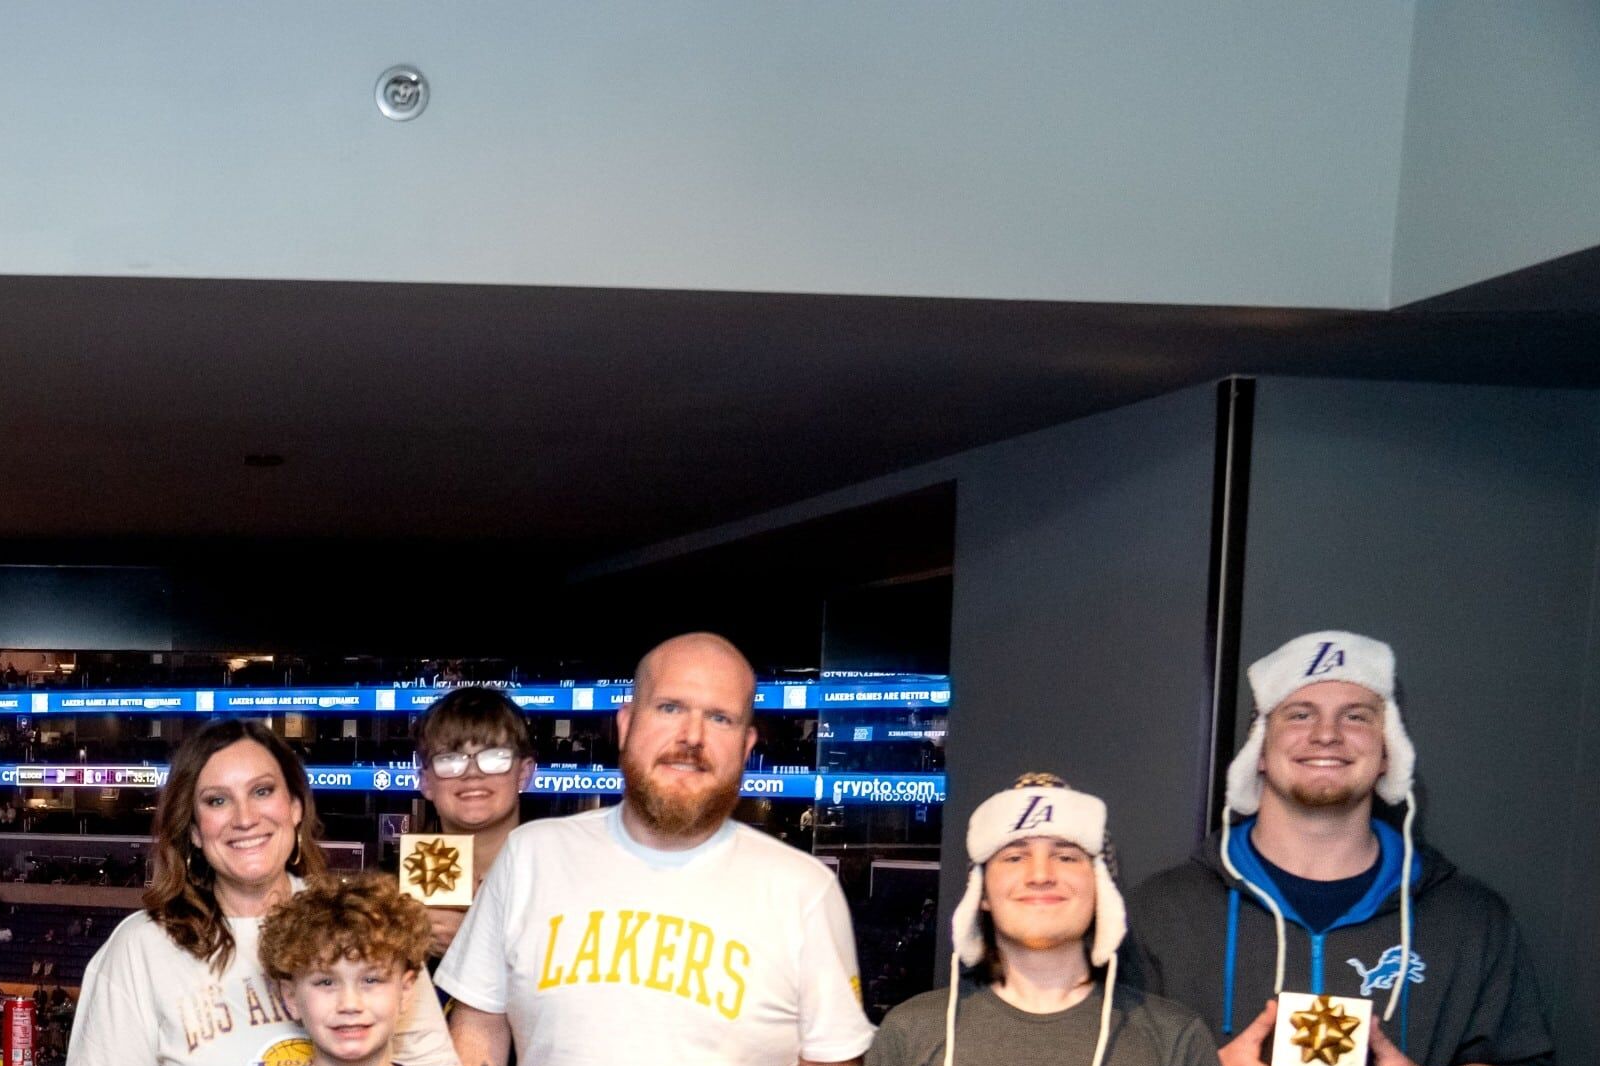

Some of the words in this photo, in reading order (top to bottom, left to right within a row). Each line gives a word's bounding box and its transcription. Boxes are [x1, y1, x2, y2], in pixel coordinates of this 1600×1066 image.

[229, 697, 254, 705] LAKERS
[825, 693, 854, 701] LAKERS
[856, 692, 882, 700] GAMES
[883, 692, 899, 700] ARE
[901, 691, 929, 700] BETTER
[833, 778, 935, 796] crypto.com
[537, 910, 750, 1020] LAKERS
